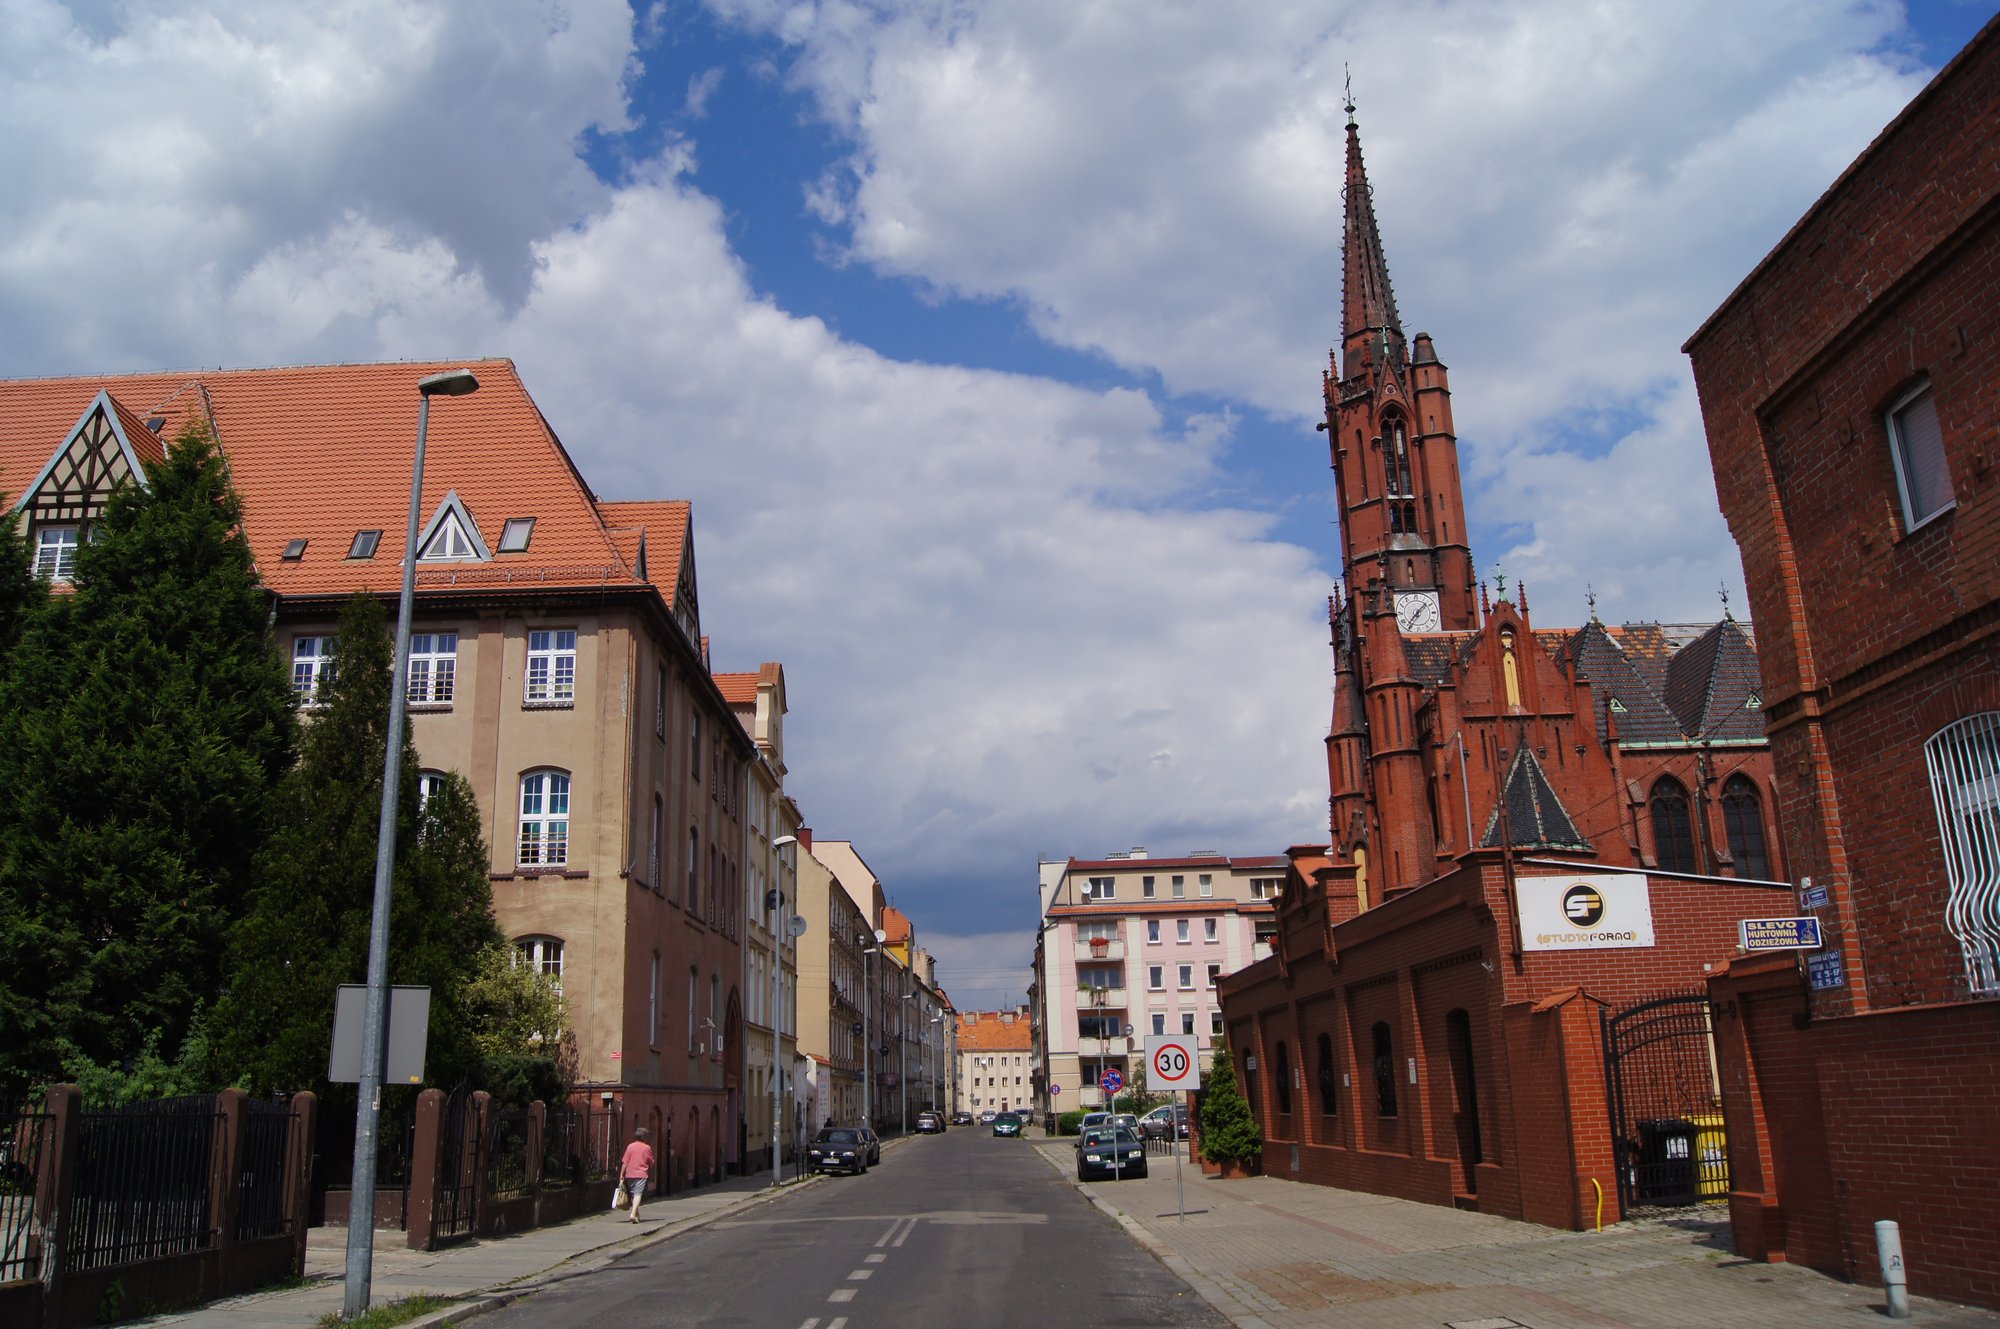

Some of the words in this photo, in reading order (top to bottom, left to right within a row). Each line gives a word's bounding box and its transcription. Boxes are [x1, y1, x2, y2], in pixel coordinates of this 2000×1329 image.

[1747, 921, 1797, 930] SLEVO
[1748, 929, 1798, 938] HURTOWNIA
[1749, 937, 1799, 947] ODZIEŻOWA
[1160, 1054, 1185, 1072] 30
